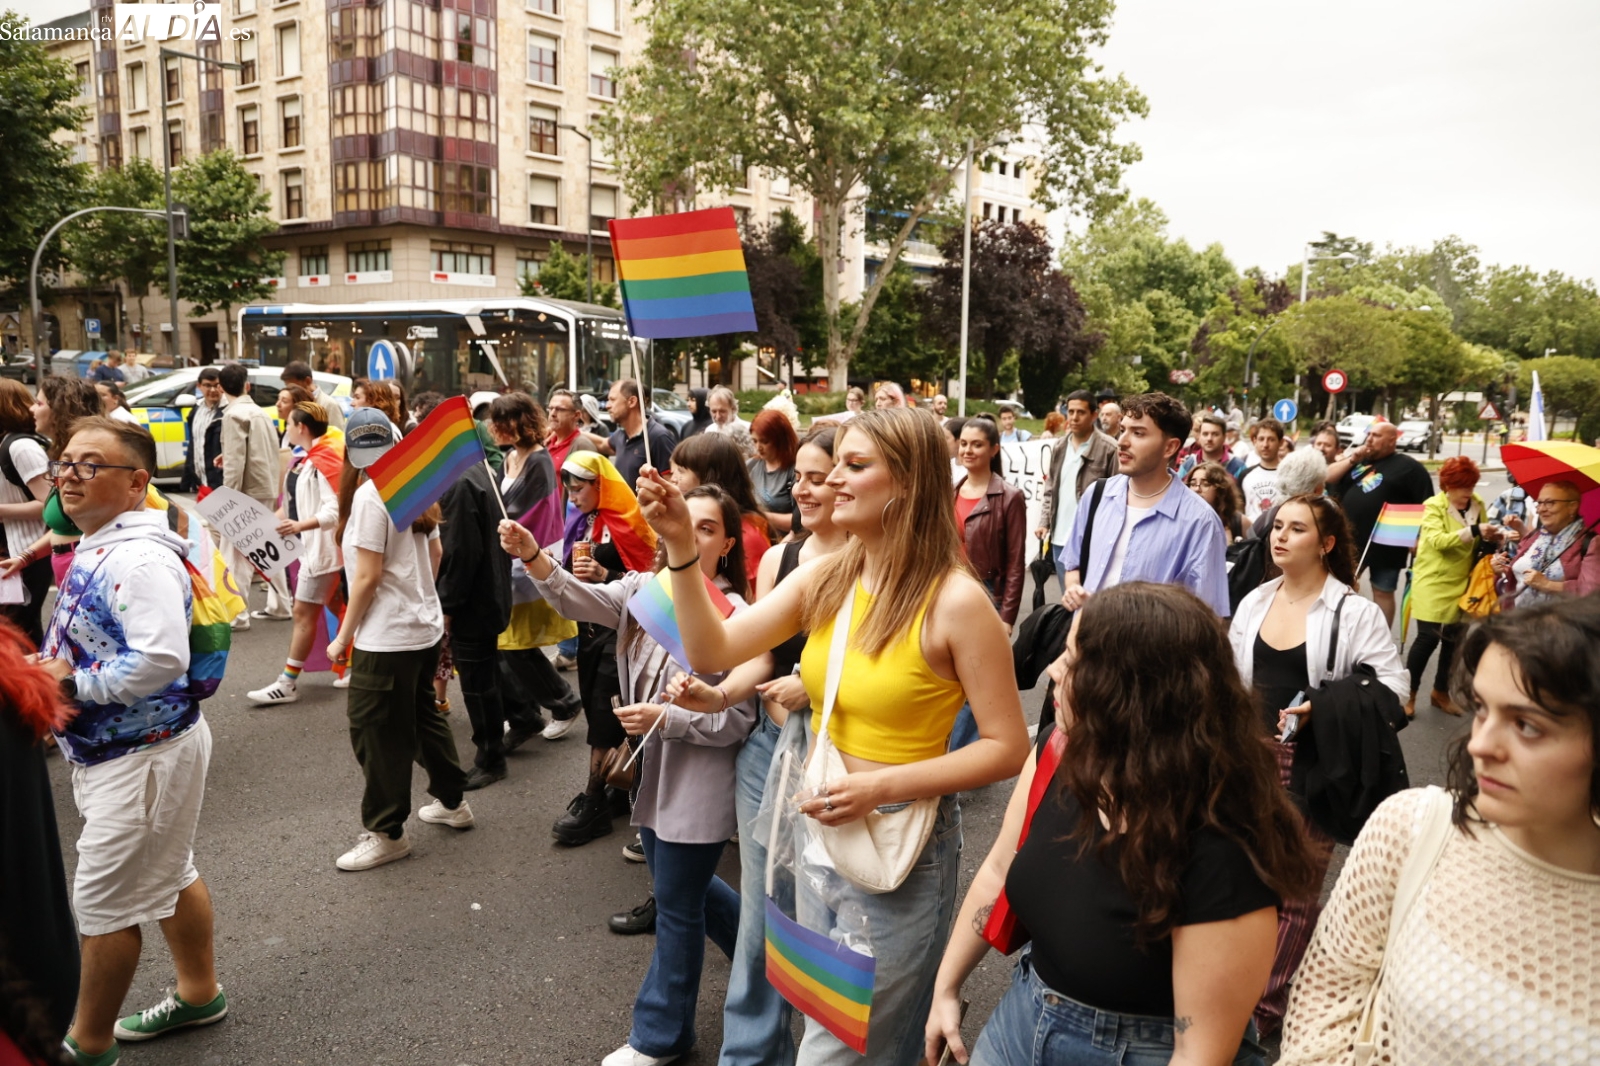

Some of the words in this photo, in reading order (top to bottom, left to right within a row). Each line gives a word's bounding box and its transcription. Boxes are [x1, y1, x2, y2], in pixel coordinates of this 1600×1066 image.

[89, 321, 97, 331] P
[1328, 376, 1342, 385] 30
[223, 506, 263, 538] GUERRA
[236, 527, 264, 550] ROPIO
